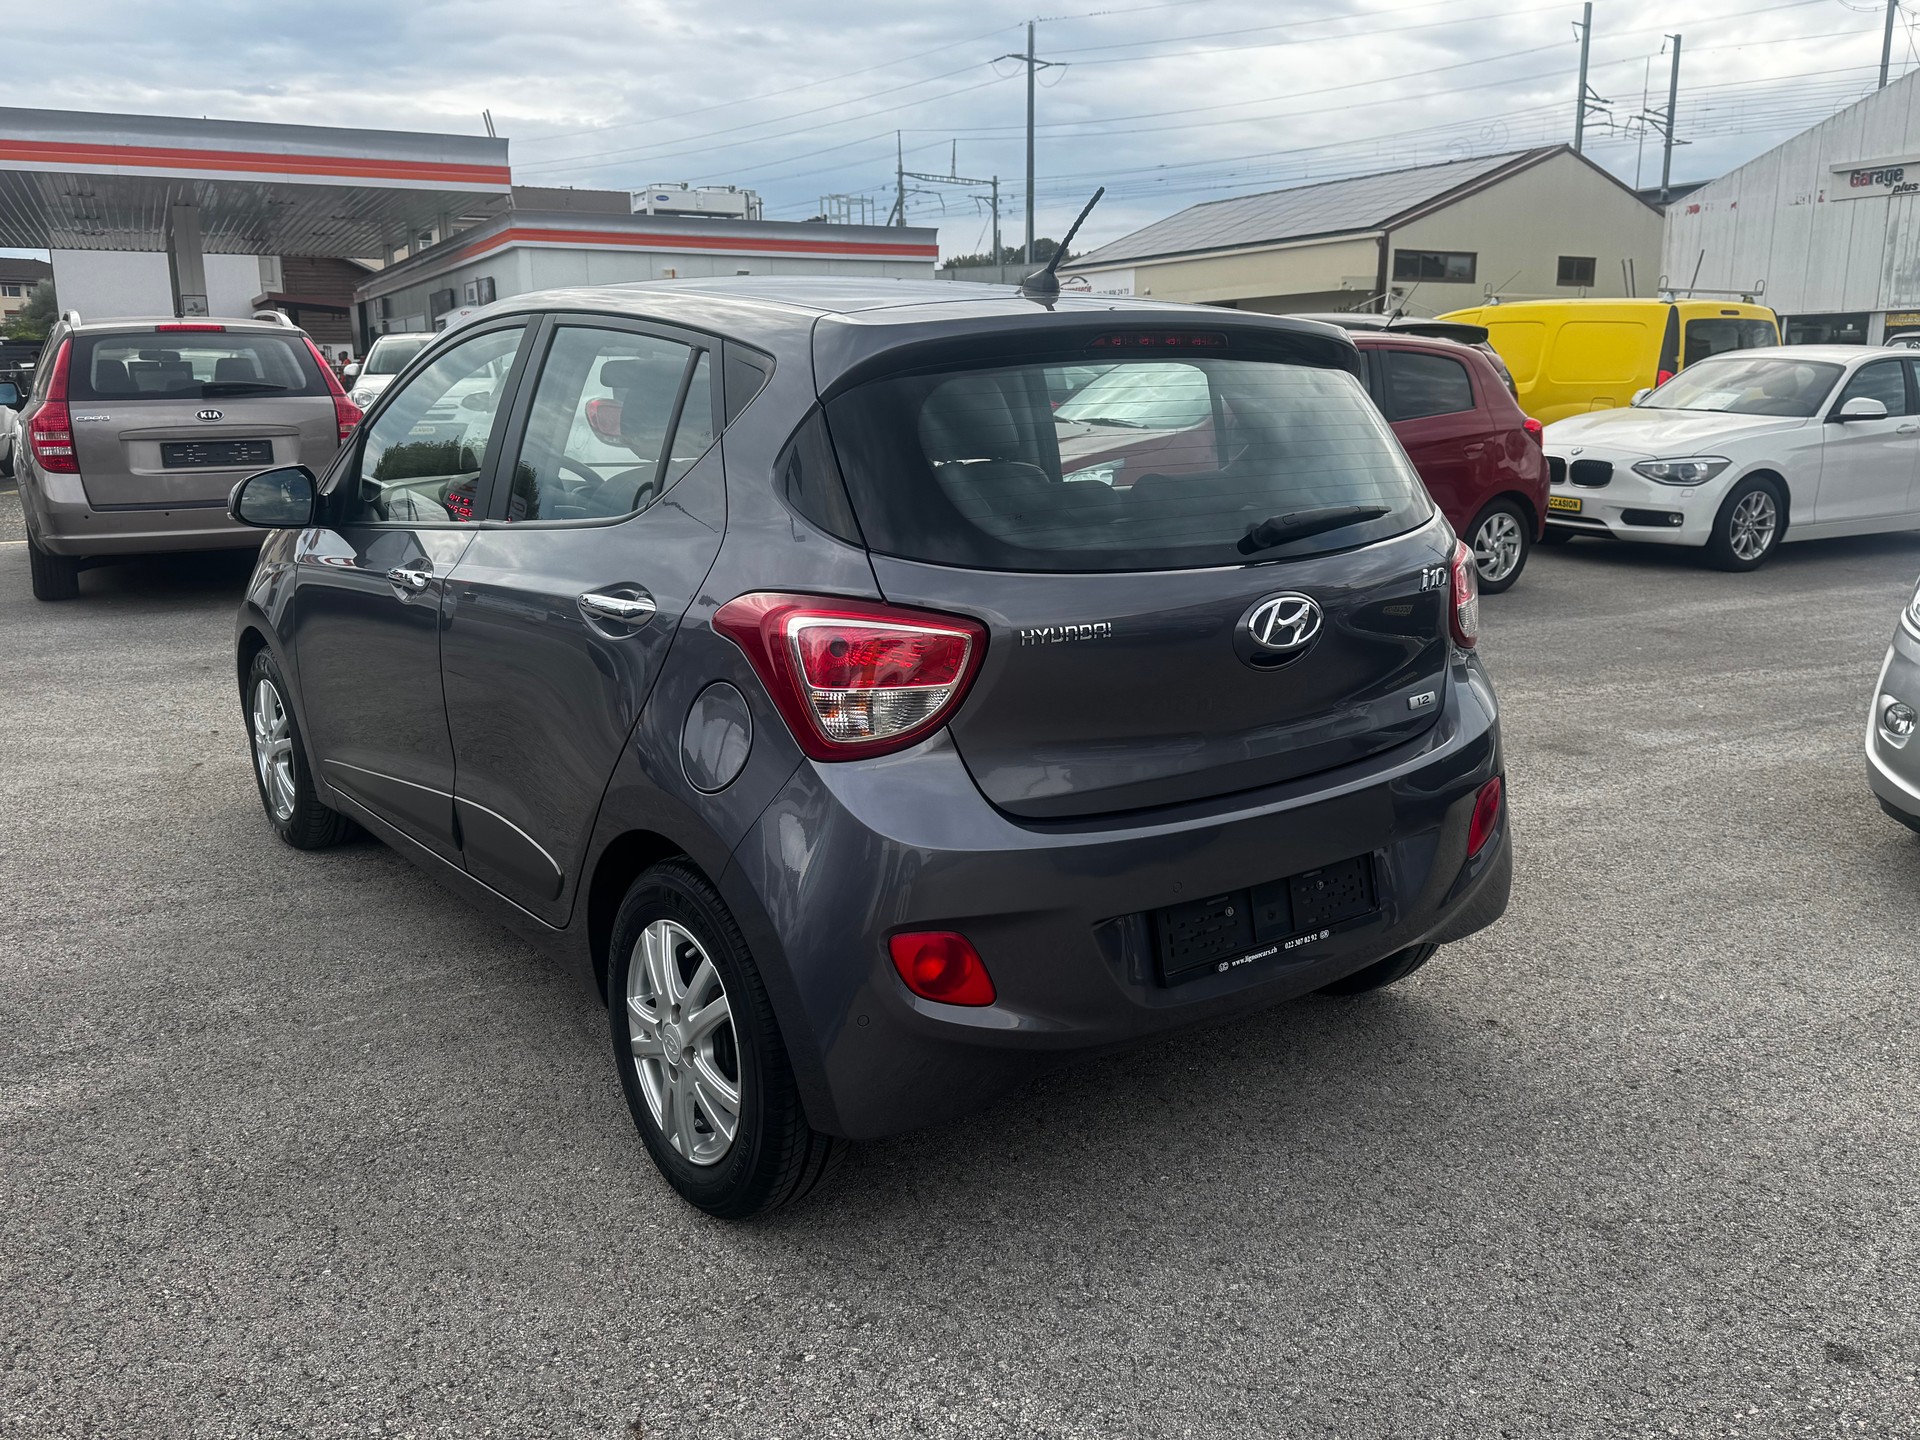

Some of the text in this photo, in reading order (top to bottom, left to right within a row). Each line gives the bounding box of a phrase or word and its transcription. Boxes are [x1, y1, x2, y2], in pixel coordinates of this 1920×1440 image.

[1850, 168, 1904, 188] Garage
[1892, 181, 1919, 195] plus
[199, 410, 221, 419] KIA
[1549, 498, 1579, 509] CCASION
[1420, 567, 1447, 592] i10
[1020, 622, 1111, 646] HYUNDAI
[1284, 940, 1295, 949] 022
[1304, 935, 1311, 944] 02
[1311, 933, 1318, 941] 92
